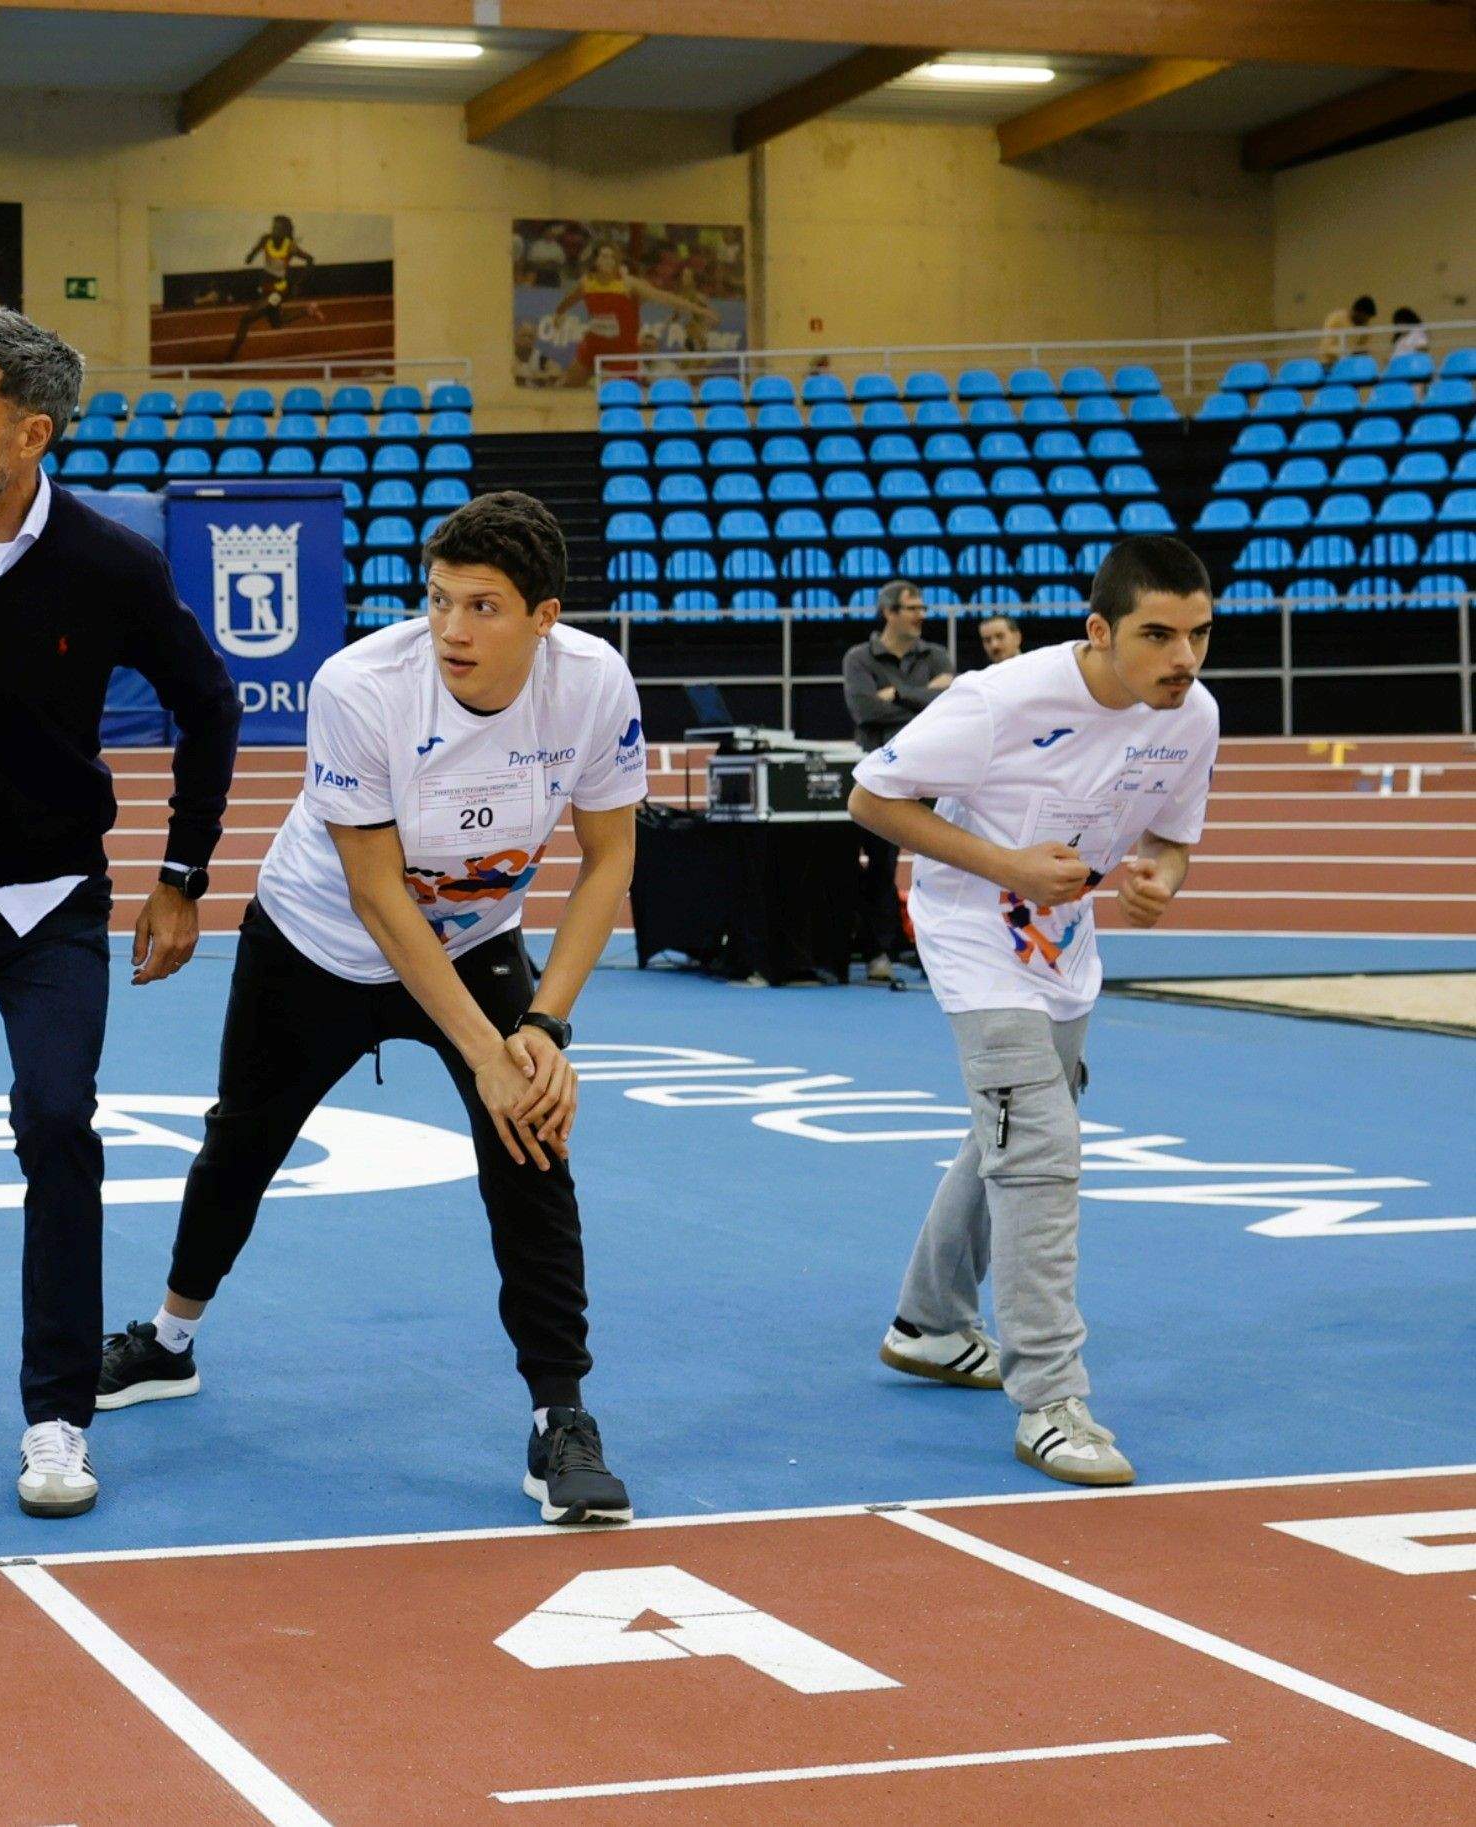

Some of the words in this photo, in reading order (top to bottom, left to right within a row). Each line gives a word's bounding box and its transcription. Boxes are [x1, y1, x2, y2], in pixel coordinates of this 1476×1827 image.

[238, 681, 307, 713] DRI
[323, 770, 359, 788] ADM
[460, 807, 494, 830] 20
[493, 1565, 905, 1694] 4
